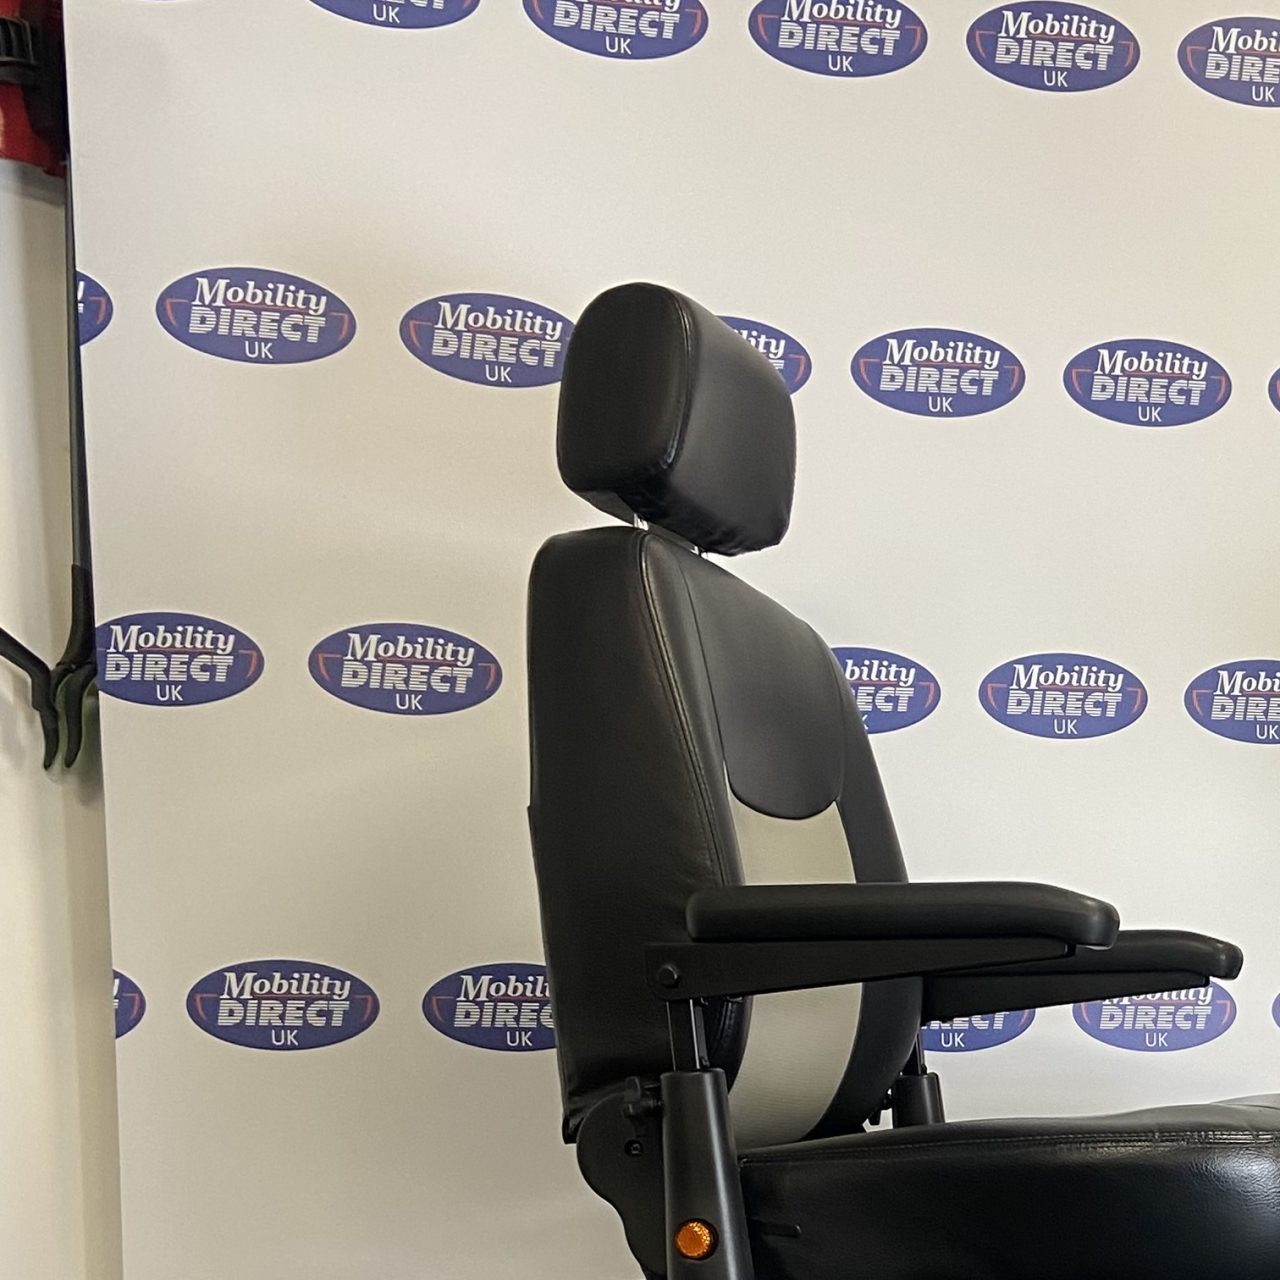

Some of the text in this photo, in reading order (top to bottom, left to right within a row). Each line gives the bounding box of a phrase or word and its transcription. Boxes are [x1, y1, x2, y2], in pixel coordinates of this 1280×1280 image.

[372, 3, 400, 23] UK
[553, 0, 680, 39] DIRECT
[780, 0, 902, 28] Mobility
[778, 21, 901, 56] DIRECT
[997, 10, 1115, 44] Mobility
[605, 35, 631, 54] UK
[995, 37, 1114, 70] DIRECT
[828, 54, 853, 72] UK
[1043, 69, 1067, 87] UK
[1251, 85, 1275, 102] UK
[190, 277, 327, 315] Mobility
[188, 306, 326, 343] DIRECT
[433, 301, 561, 341] Mobility
[245, 340, 273, 359] UK
[431, 329, 561, 367] DIRECT
[881, 338, 1000, 369] Mobility
[485, 364, 511, 383] UK
[1093, 348, 1208, 380] Mobility
[879, 365, 999, 395] DIRECT
[1091, 375, 1206, 405] DIRECT
[928, 395, 952, 412] UK
[1138, 405, 1161, 422] UK
[104, 624, 234, 654] Mobility
[343, 633, 475, 667] Mobility
[103, 653, 233, 682] DIRECT
[340, 661, 473, 693] DIRECT
[1008, 664, 1124, 692] Mobility
[157, 684, 184, 701] UK
[395, 693, 422, 711] UK
[852, 686, 915, 712] ECT
[1006, 690, 1122, 717] DIRECT
[1054, 718, 1077, 734] UK
[1256, 724, 1279, 739] UK
[219, 972, 351, 1000] Mobility
[217, 999, 350, 1027] DIRECT
[1100, 1005, 1212, 1030] DIRECT
[271, 1029, 298, 1046] UK
[506, 1030, 532, 1047] UK
[941, 1033, 965, 1048] UK
[1145, 1033, 1168, 1047] UK
